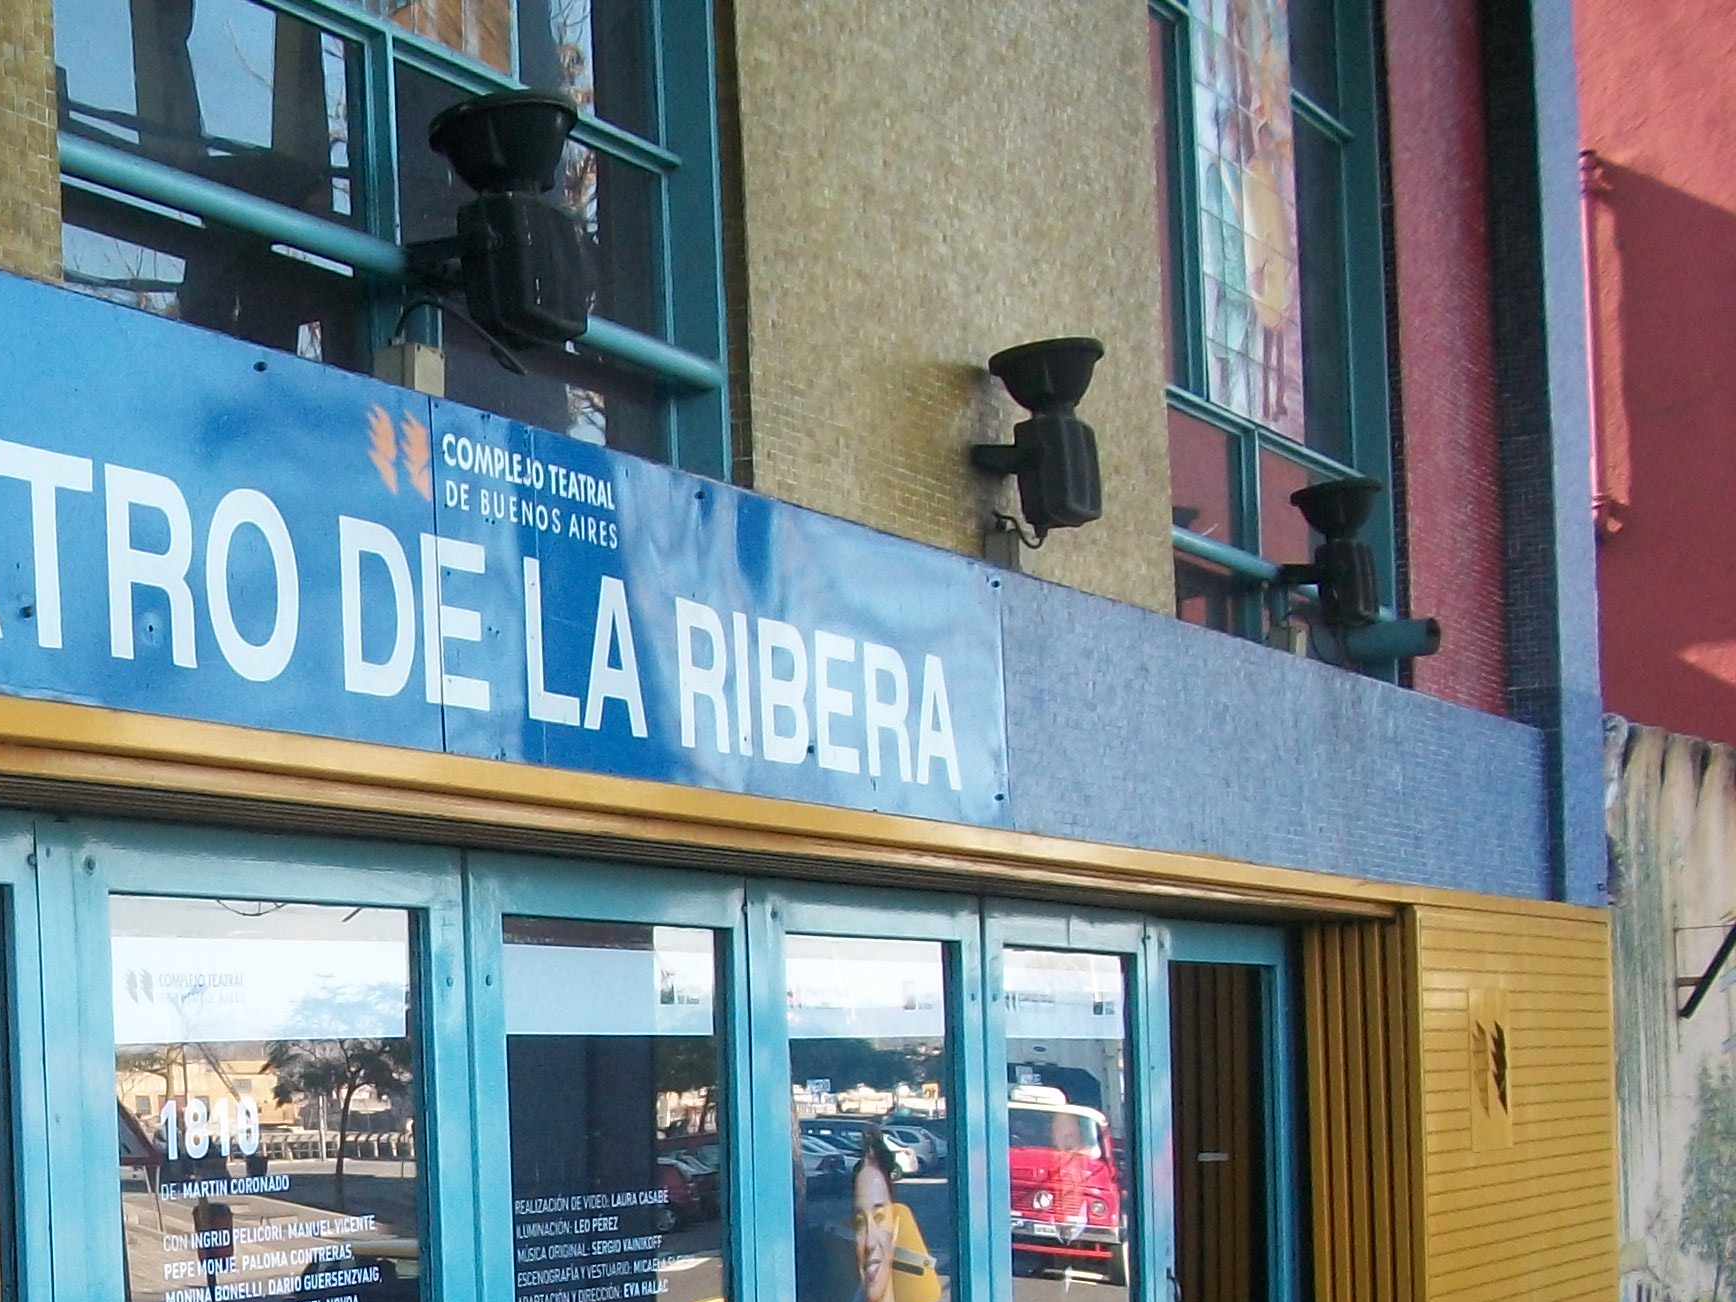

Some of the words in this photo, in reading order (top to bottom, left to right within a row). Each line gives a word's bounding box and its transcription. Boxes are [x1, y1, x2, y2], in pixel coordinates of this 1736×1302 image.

[442, 432, 544, 490] COMPLEJO
[547, 463, 617, 511] TEATRAL
[445, 479, 470, 512] DE
[480, 488, 562, 535] BUENOS
[568, 512, 619, 550] AIRES
[338, 514, 491, 711] DE
[523, 555, 648, 739] LA
[675, 595, 962, 791] RIBERA
[160, 1096, 260, 1160] 1810
[230, 1174, 290, 1195] CORONADO
[515, 1194, 569, 1215] REALIZACIÓN
[570, 1196, 582, 1211] DE
[611, 1190, 638, 1208] LAURA
[163, 1233, 188, 1252] CON
[191, 1229, 230, 1249] INGRID
[287, 1219, 334, 1239] MANUEL
[334, 1214, 376, 1234] VICENTE
[574, 1219, 591, 1235] LEO
[592, 1213, 619, 1232] PÉREZ
[517, 1244, 547, 1263] MÚSICA
[592, 1239, 622, 1256] SERGIO
[164, 1261, 195, 1280] PEPE
[242, 1251, 288, 1271] PALOMA
[268, 1272, 302, 1295] DARÍO
[624, 1282, 640, 1298] EVA
[641, 1278, 670, 1296] HALAC
